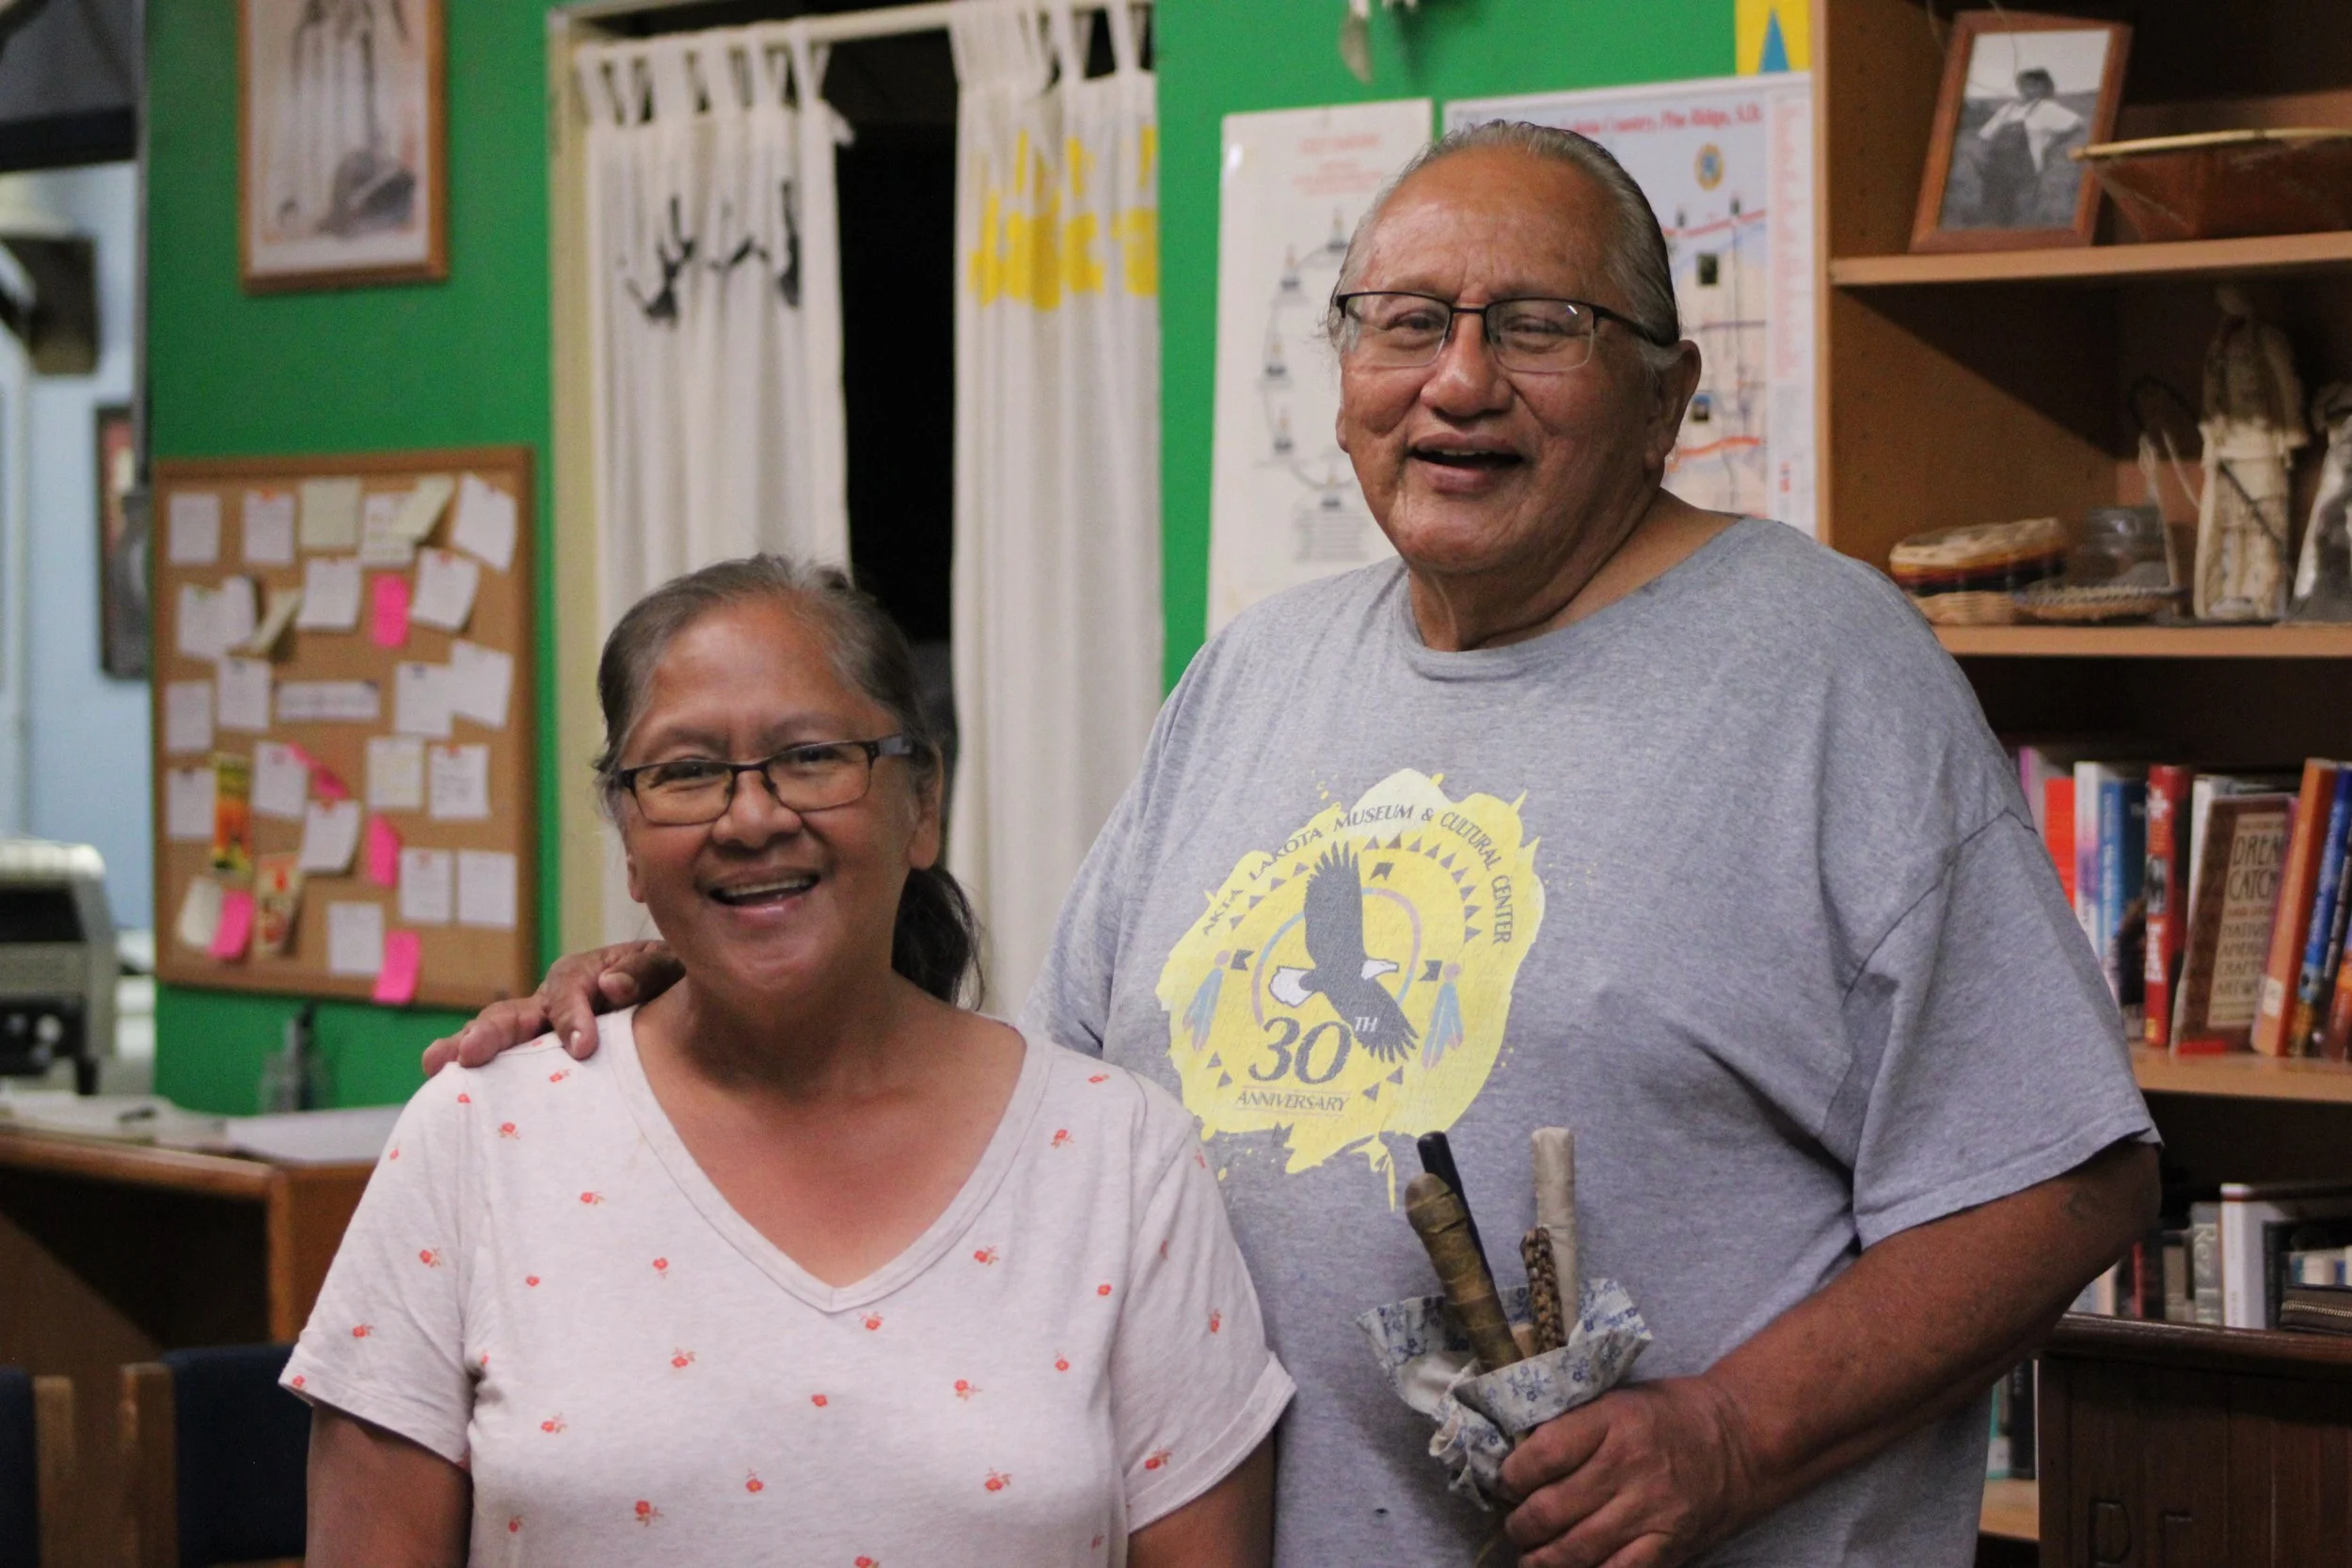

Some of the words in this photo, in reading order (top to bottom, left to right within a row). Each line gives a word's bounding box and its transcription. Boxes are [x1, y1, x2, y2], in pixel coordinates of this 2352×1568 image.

[1202, 888, 1244, 936] AKTA
[1248, 827, 1324, 880] LAKOTA
[1333, 804, 1414, 832] MUSEUM
[1421, 807, 1435, 822] &
[1439, 812, 1502, 871] CULTURAL
[1491, 875, 1514, 945] CENTER
[1235, 1089, 1350, 1112] ANNIVERSARY
